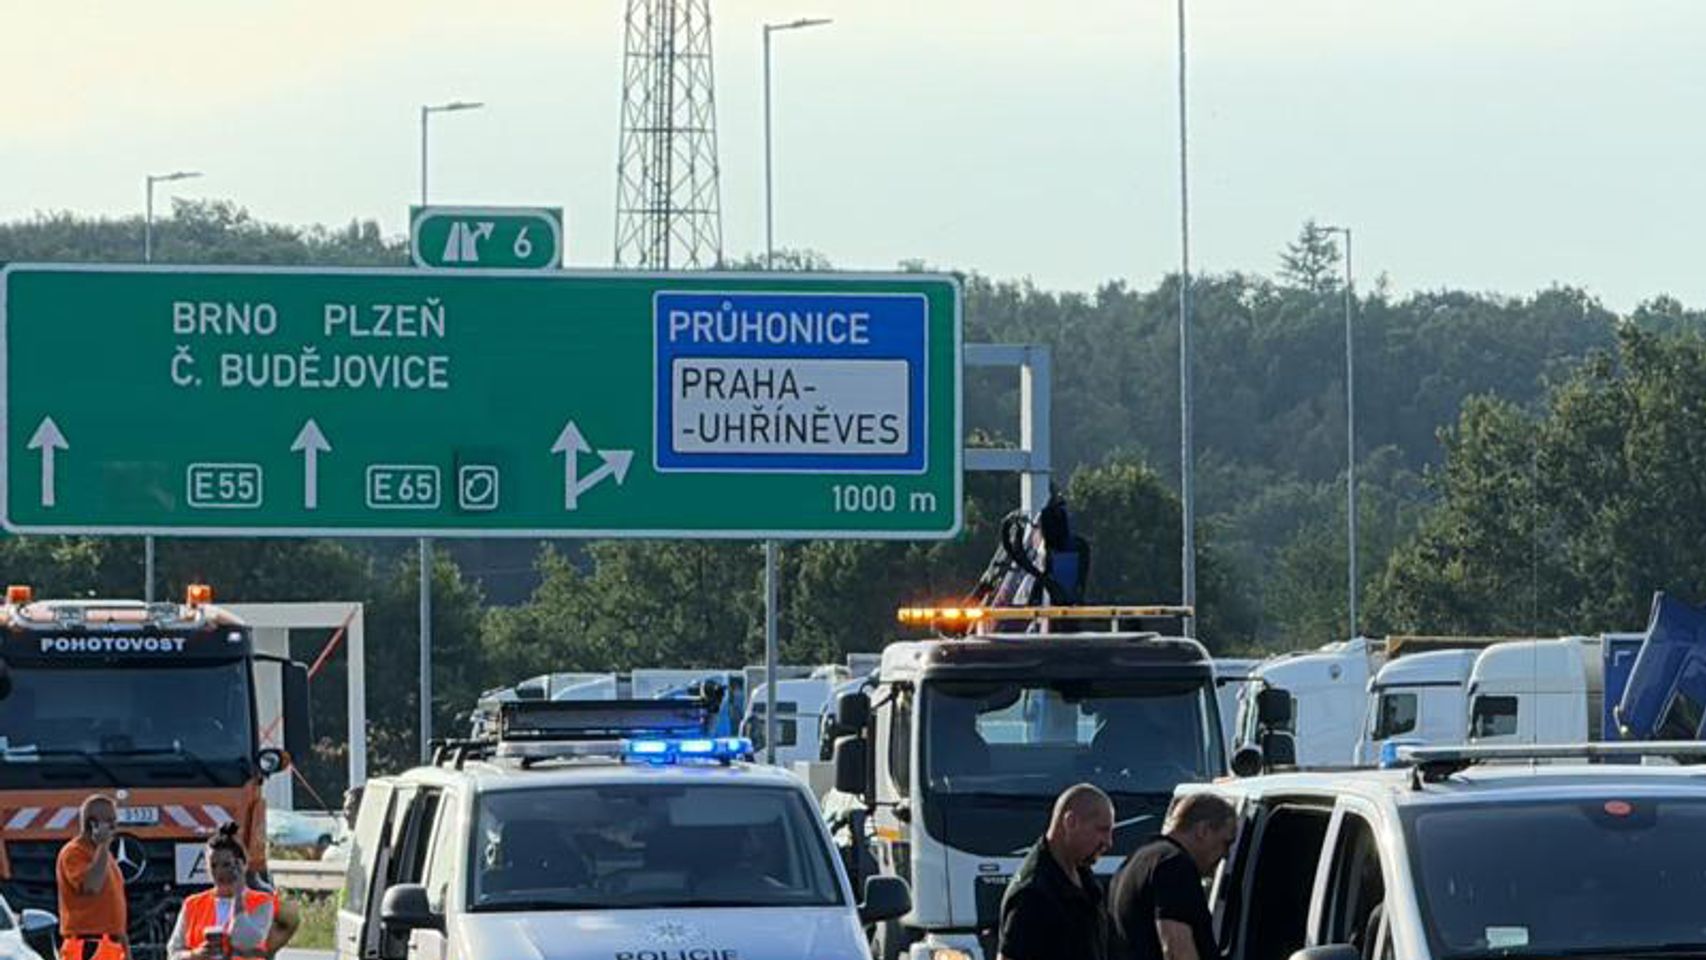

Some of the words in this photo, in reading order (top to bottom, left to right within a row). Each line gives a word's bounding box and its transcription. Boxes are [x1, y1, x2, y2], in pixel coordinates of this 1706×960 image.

[513, 226, 532, 258] 6
[172, 301, 278, 335] BRNO
[324, 297, 446, 337] PLZEŇ
[669, 300, 870, 344] PRŮHONICE
[171, 344, 202, 386] Č.
[220, 345, 449, 389] BUDĚJOVICE
[681, 367, 817, 400] PRAHA-
[682, 403, 900, 445] -UHŘÍNĚVES
[832, 484, 896, 512] 1000
[909, 493, 937, 512] m
[40, 636, 188, 652] POHOTOVOST
